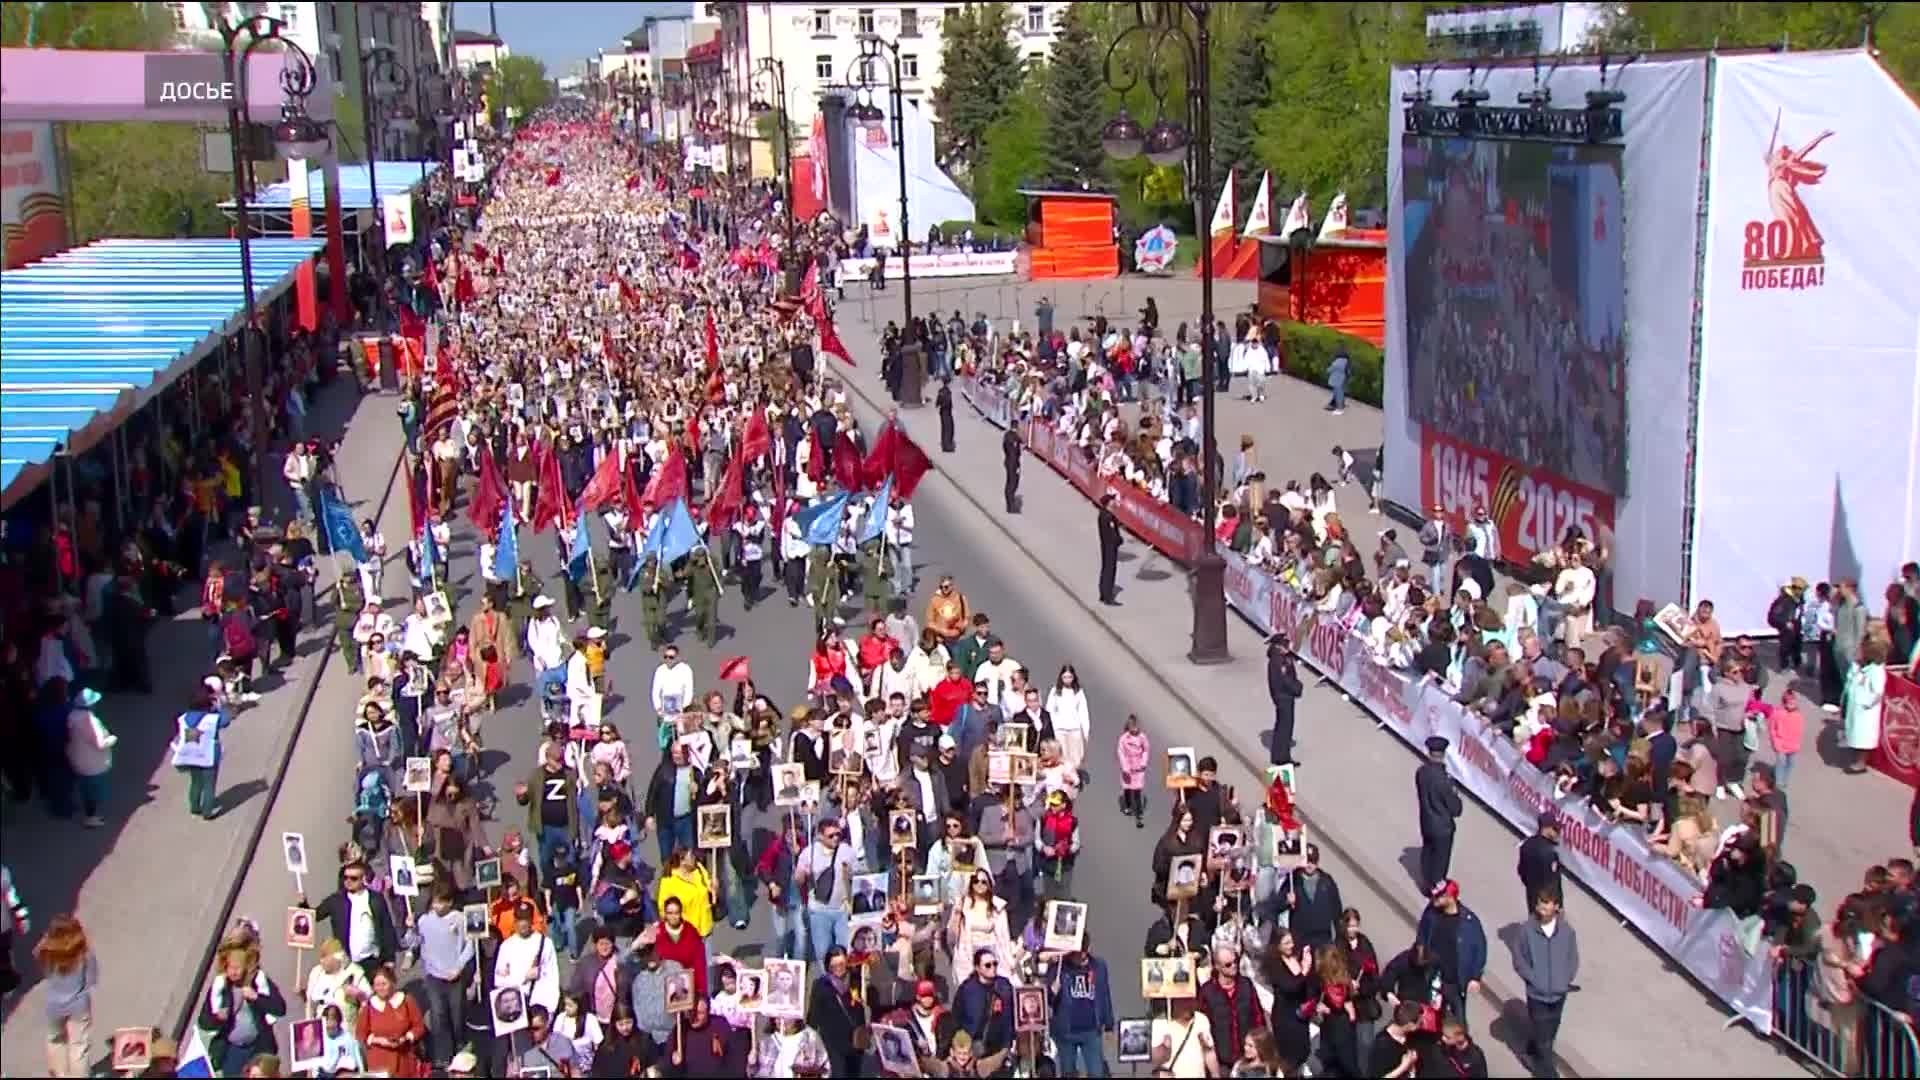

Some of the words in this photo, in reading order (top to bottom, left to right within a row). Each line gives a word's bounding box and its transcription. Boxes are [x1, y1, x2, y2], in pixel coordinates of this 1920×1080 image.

[1744, 220, 1789, 260] 80
[1741, 267, 1825, 290] ПОБЕДА!
[1431, 442, 1489, 519] 1945
[1518, 474, 1596, 552] 2025
[545, 778, 567, 801] Z
[1613, 848, 1688, 936] ДОБЛЕСТИ!
